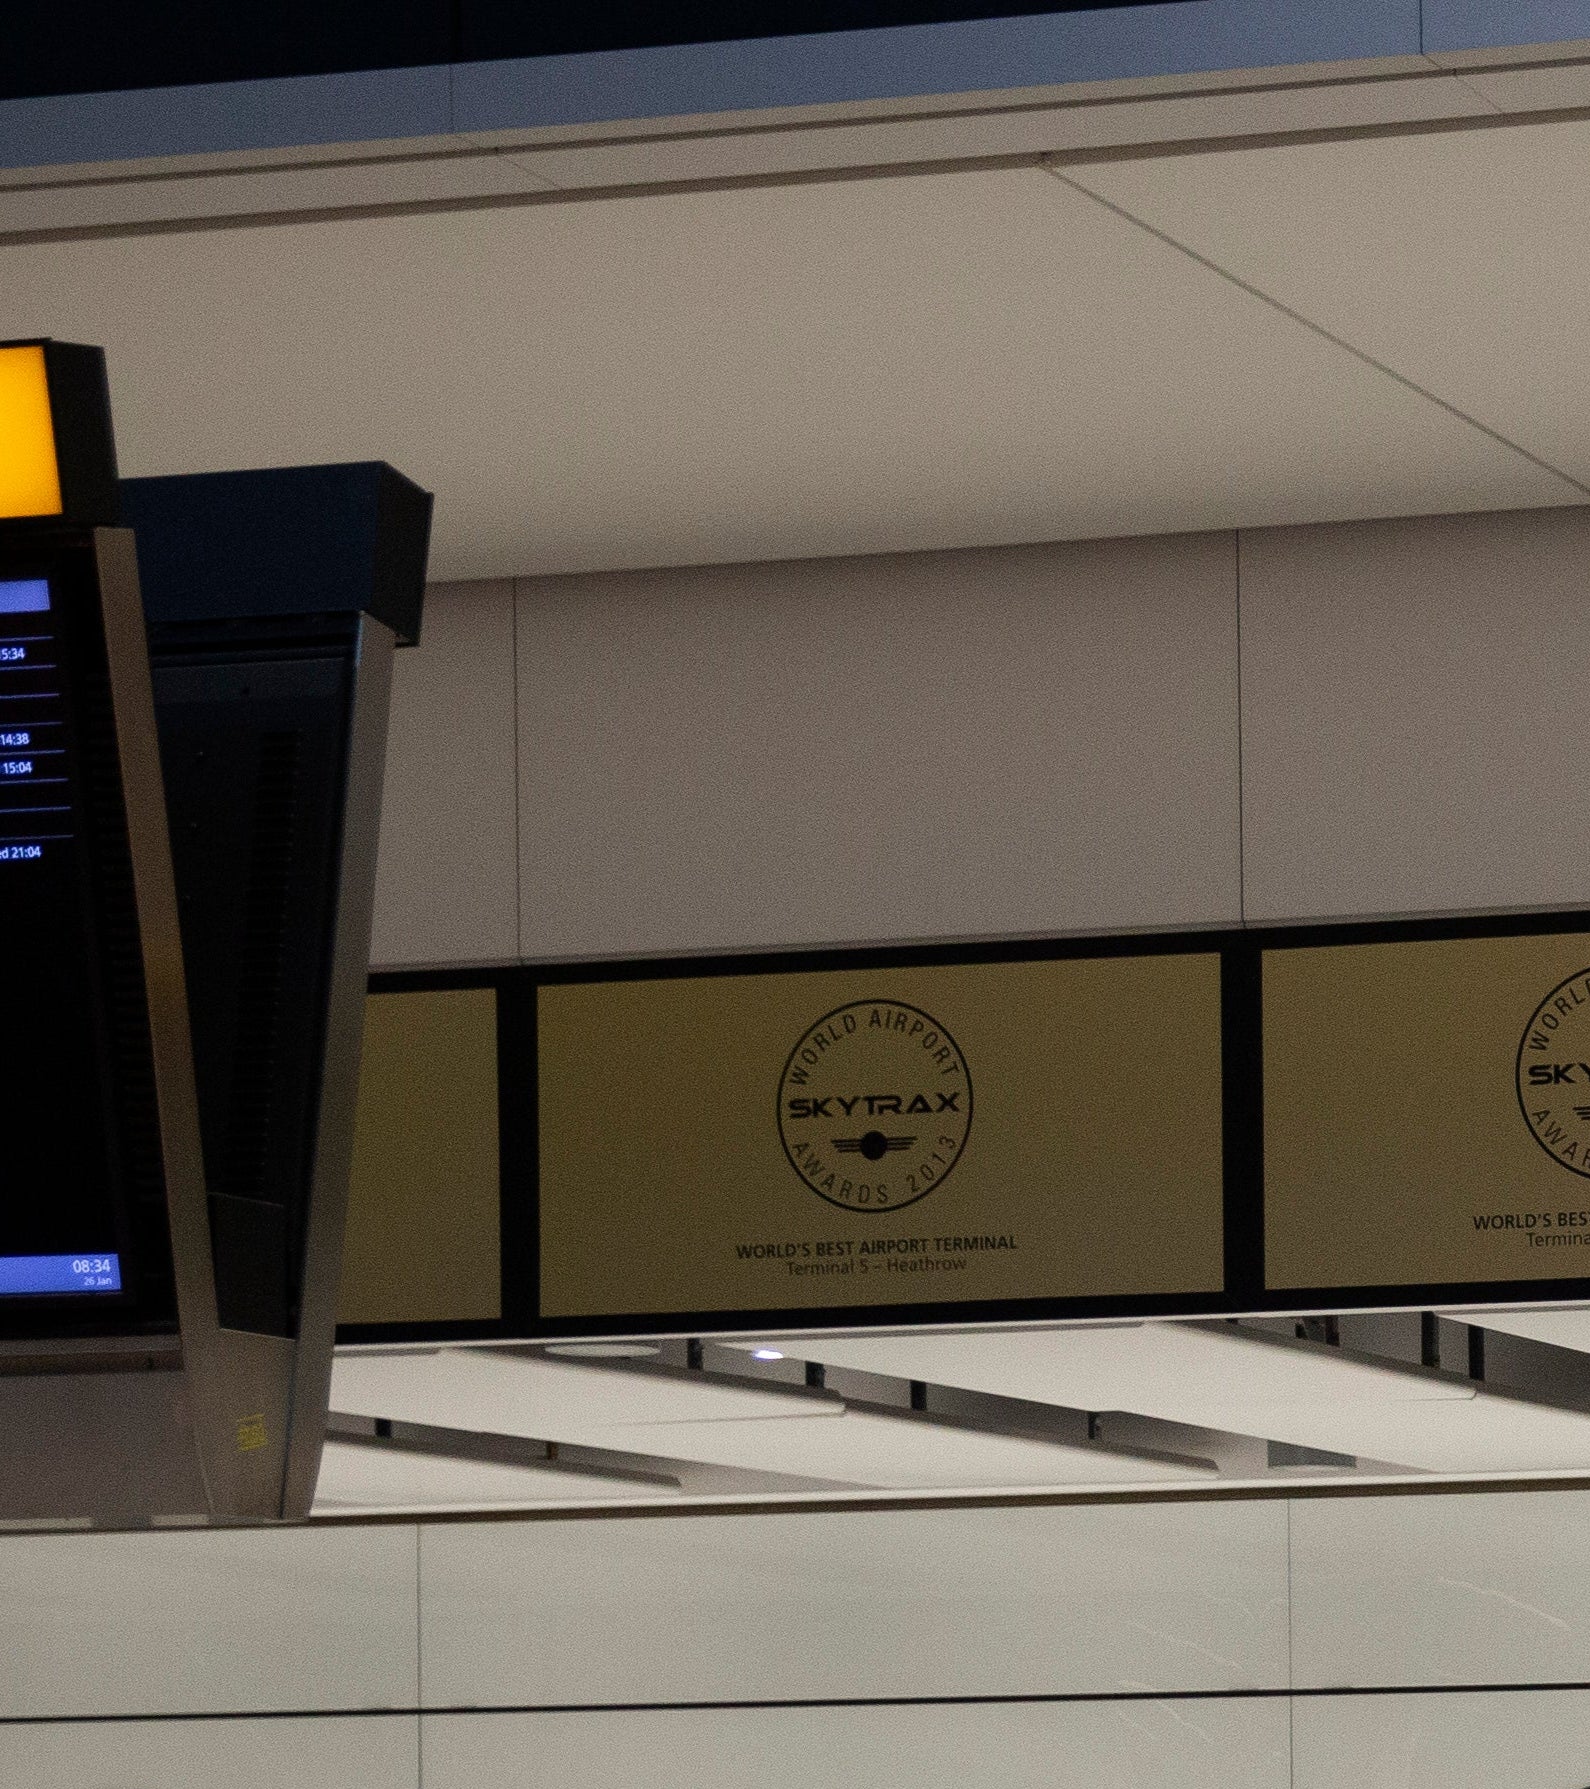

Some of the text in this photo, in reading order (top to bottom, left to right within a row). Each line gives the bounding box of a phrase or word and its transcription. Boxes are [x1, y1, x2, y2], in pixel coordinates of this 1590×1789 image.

[0, 647, 25, 660] 5:34
[3, 762, 32, 774] 15:04
[11, 846, 41, 859] 21:04
[790, 1009, 959, 1087] WORLD AIRPORT
[789, 1092, 959, 1119] SKYTRAX
[792, 1142, 888, 1204] AWARDS
[1473, 1213, 1550, 1230] WORLD'S
[736, 1236, 1017, 1259] WORLD'S BEST AIRPORT TERMINAL
[73, 1259, 111, 1273] 08:34
[788, 1260, 854, 1275] Terminal
[860, 1259, 868, 1274] 5
[887, 1255, 966, 1273] Heathrow
[96, 1276, 112, 1286] Jan
